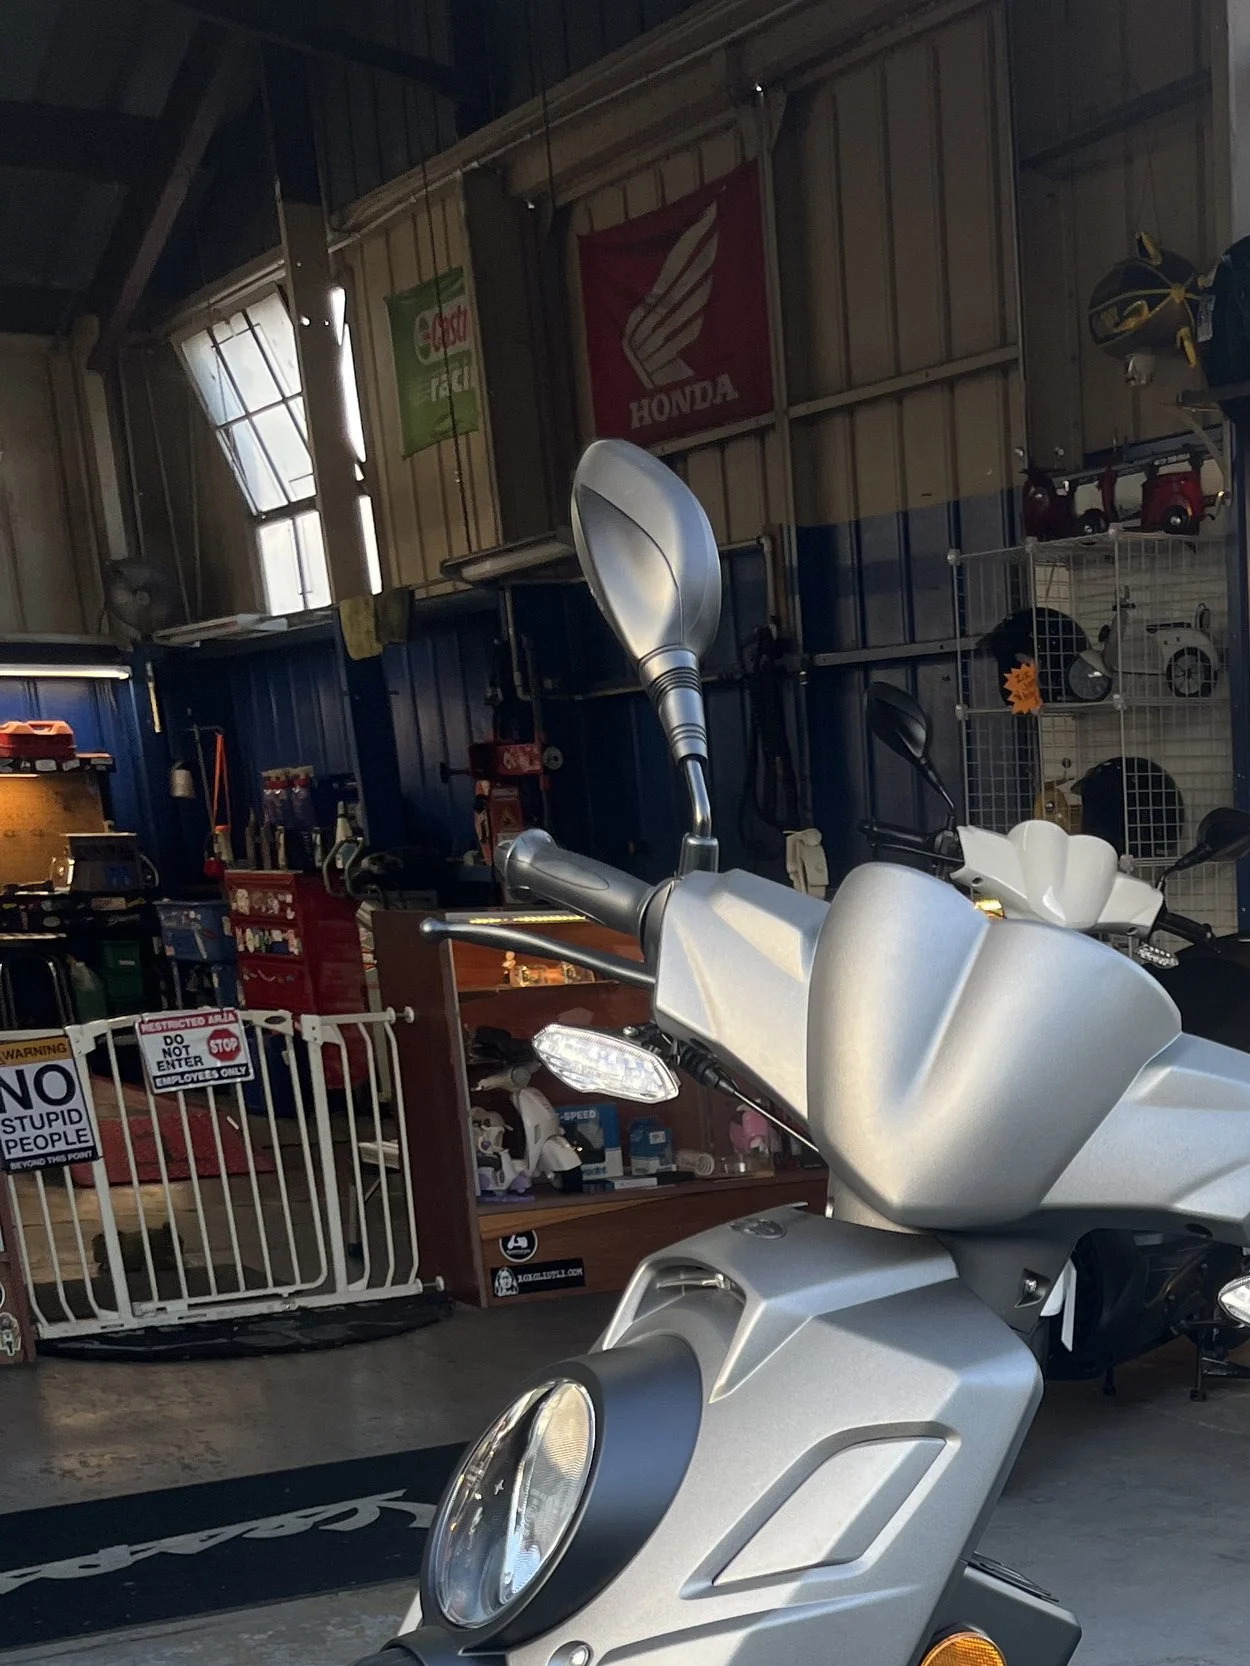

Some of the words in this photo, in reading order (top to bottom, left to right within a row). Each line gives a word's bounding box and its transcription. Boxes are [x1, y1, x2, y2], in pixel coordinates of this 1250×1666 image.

[629, 374, 738, 429] HONDA
[141, 1016, 206, 1033] RESTRICTED
[163, 1033, 185, 1047] DO
[209, 1037, 239, 1054] STOP
[1, 1042, 67, 1060] WARNING
[162, 1044, 191, 1060] NOT
[156, 1055, 204, 1072] ENTER
[155, 1069, 219, 1087] EMPLOYEES
[220, 1066, 247, 1078] ONLY
[0, 1063, 76, 1113] NO
[1, 1108, 83, 1135] STUPID
[5, 1128, 90, 1155] PEOPLE
[10, 1158, 46, 1170] BEYOND
[47, 1154, 67, 1164] THIS
[68, 1150, 93, 1161] POINT
